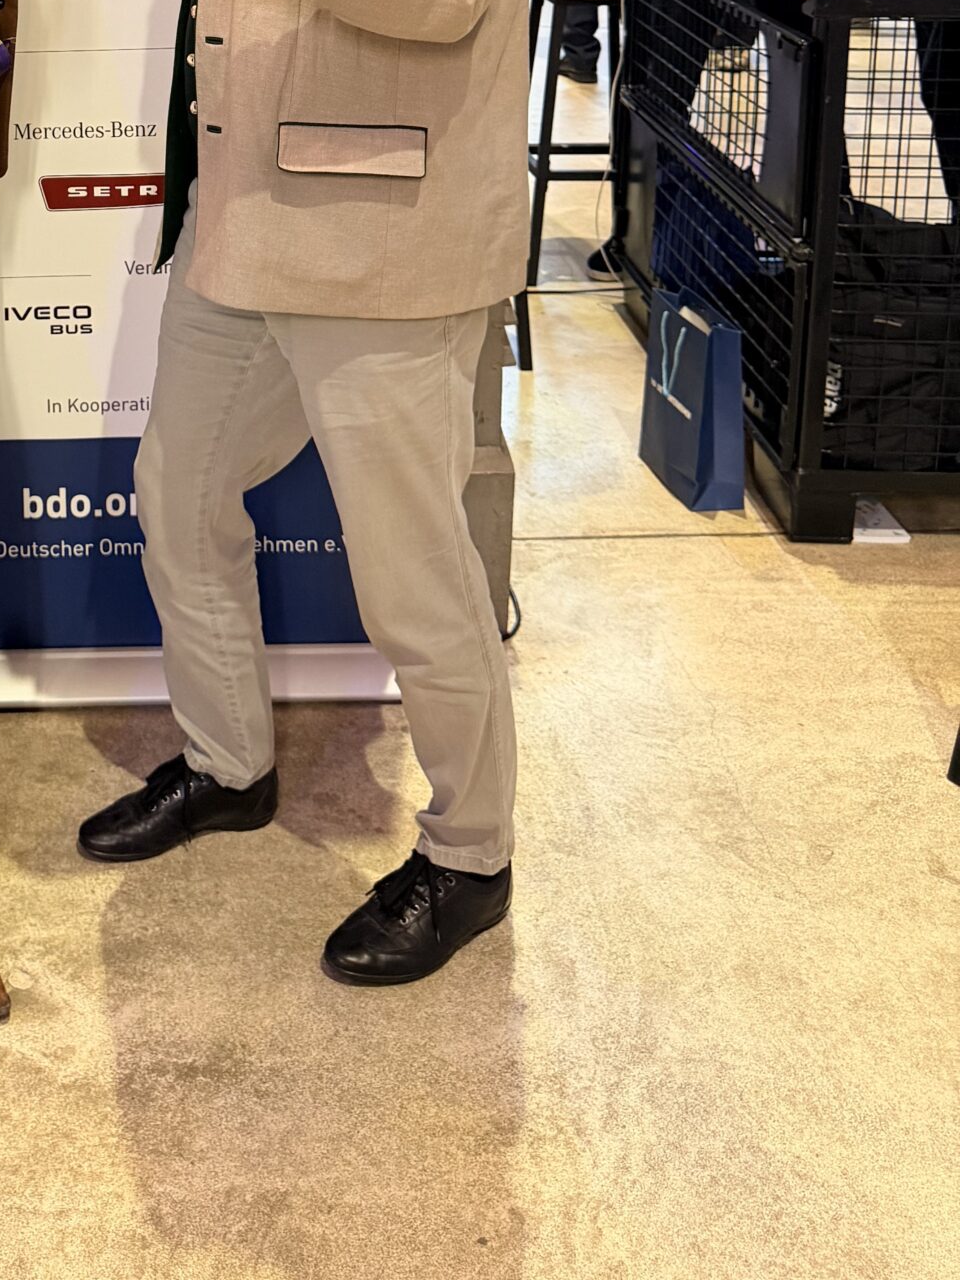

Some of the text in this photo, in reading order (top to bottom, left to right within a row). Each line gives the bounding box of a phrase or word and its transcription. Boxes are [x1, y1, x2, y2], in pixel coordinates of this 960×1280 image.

[14, 120, 158, 140] Mercedes-Benz
[68, 184, 158, 198] SETR
[4, 305, 92, 321] IVECO
[50, 324, 93, 335] BUS
[47, 396, 150, 415] In Kooperati
[100, 538, 144, 556] Omn
[254, 535, 318, 552] ehmen
